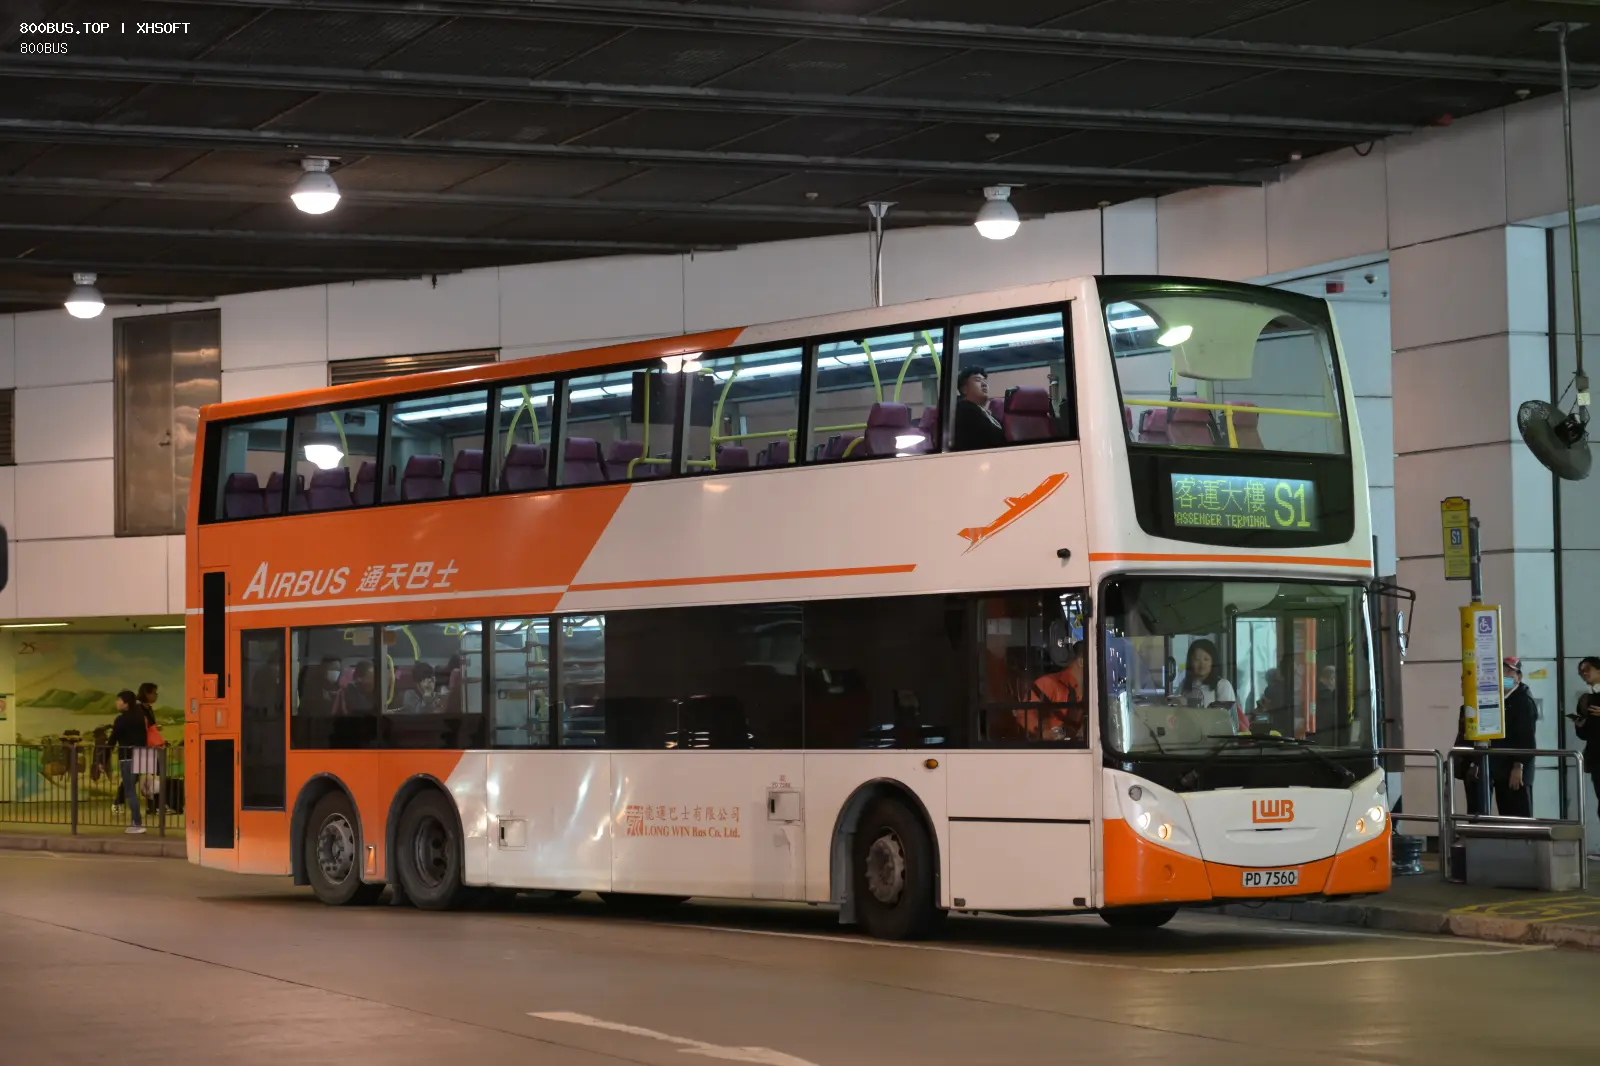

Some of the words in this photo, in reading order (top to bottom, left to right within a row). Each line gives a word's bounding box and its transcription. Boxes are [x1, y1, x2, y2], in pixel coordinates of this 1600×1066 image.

[1174, 476, 1266, 512] 客運大樓
[1274, 482, 1311, 528] S1
[1225, 514, 1270, 529] TERMINAL
[1451, 530, 1461, 544] S1
[355, 559, 459, 592] 通天巴士
[1252, 799, 1295, 824] LWB
[644, 825, 670, 837] LONG
[672, 825, 690, 837] WIN
[692, 827, 707, 837] Bus
[724, 827, 741, 838] Ltd.
[1245, 872, 1262, 886] PD
[1265, 871, 1296, 886] 7560
